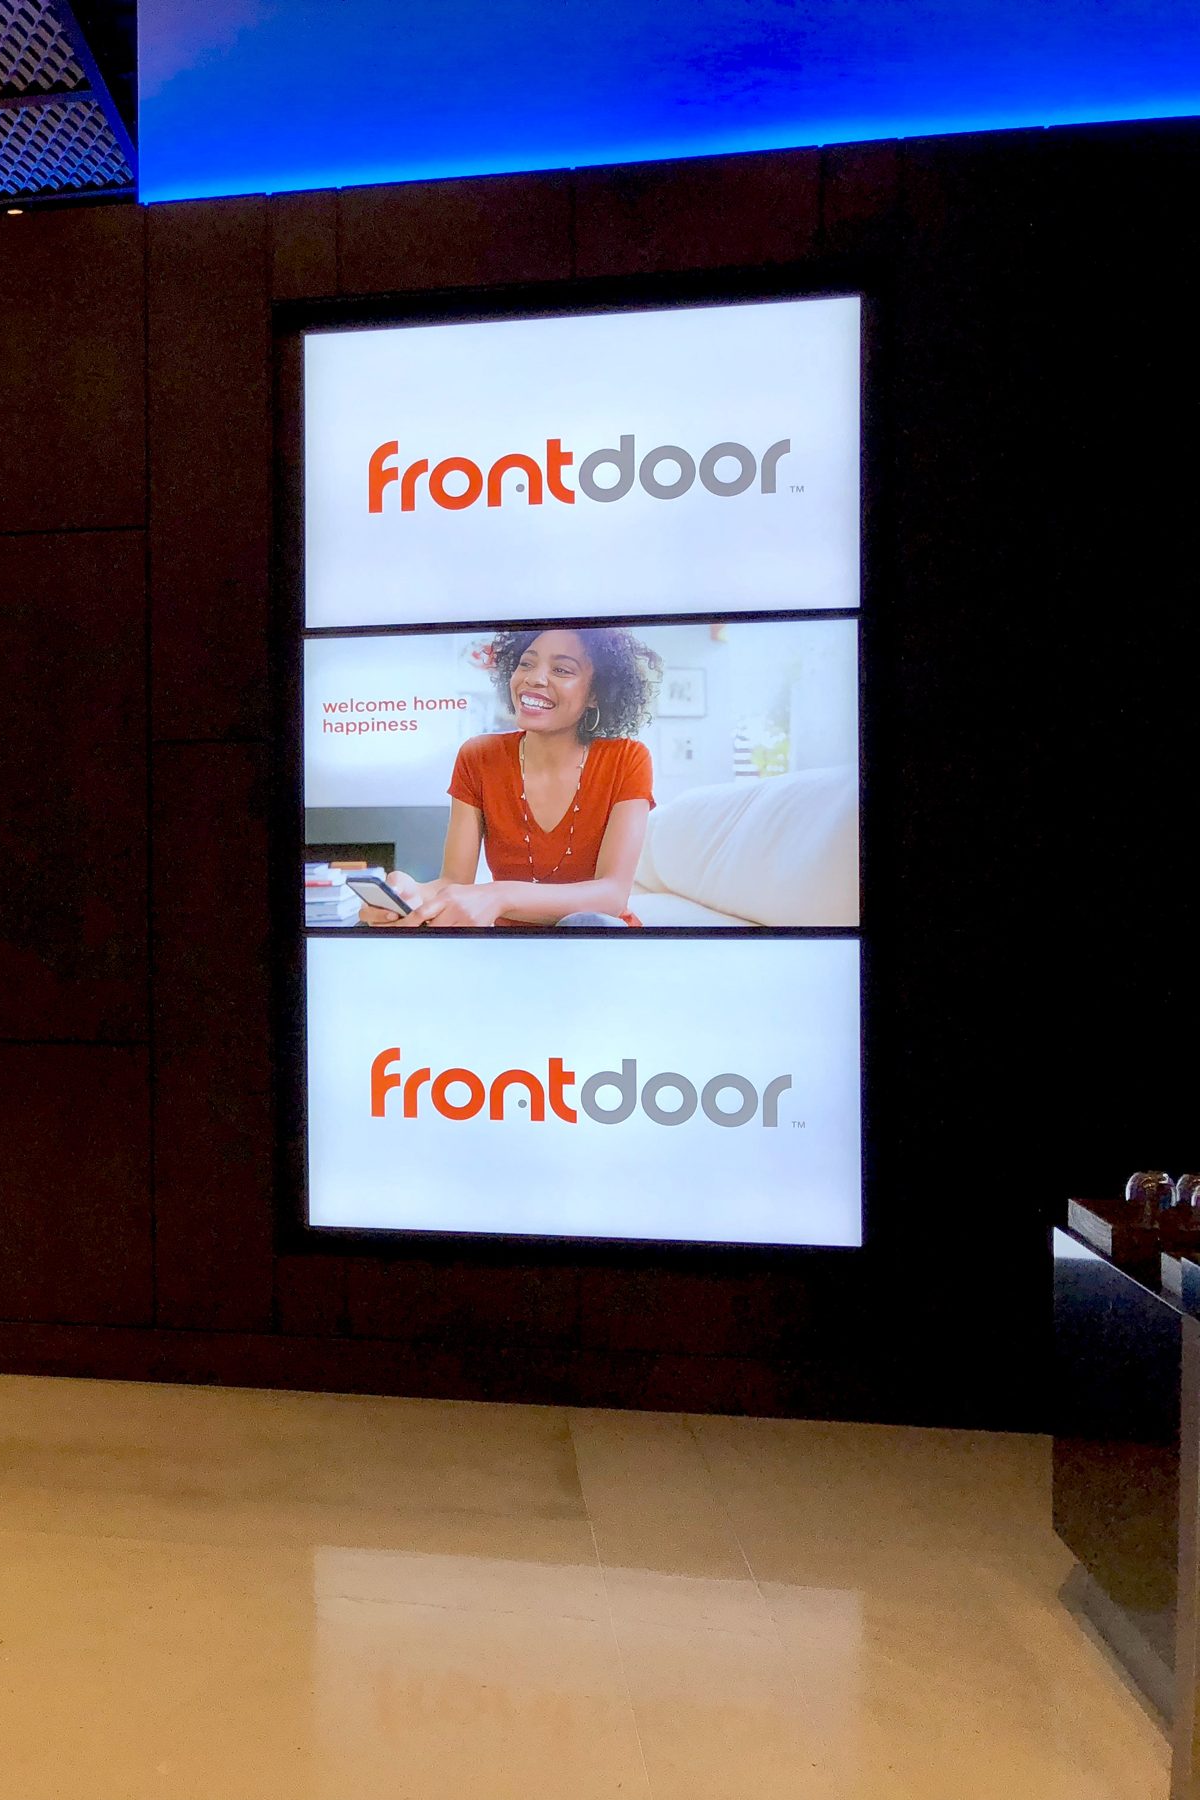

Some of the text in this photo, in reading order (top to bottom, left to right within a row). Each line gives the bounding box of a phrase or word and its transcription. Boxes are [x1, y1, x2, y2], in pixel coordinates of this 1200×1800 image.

[368, 433, 791, 514] frontdoor
[322, 696, 468, 714] welcome home
[322, 717, 418, 735] happiness
[371, 1046, 792, 1128] frontdoor
